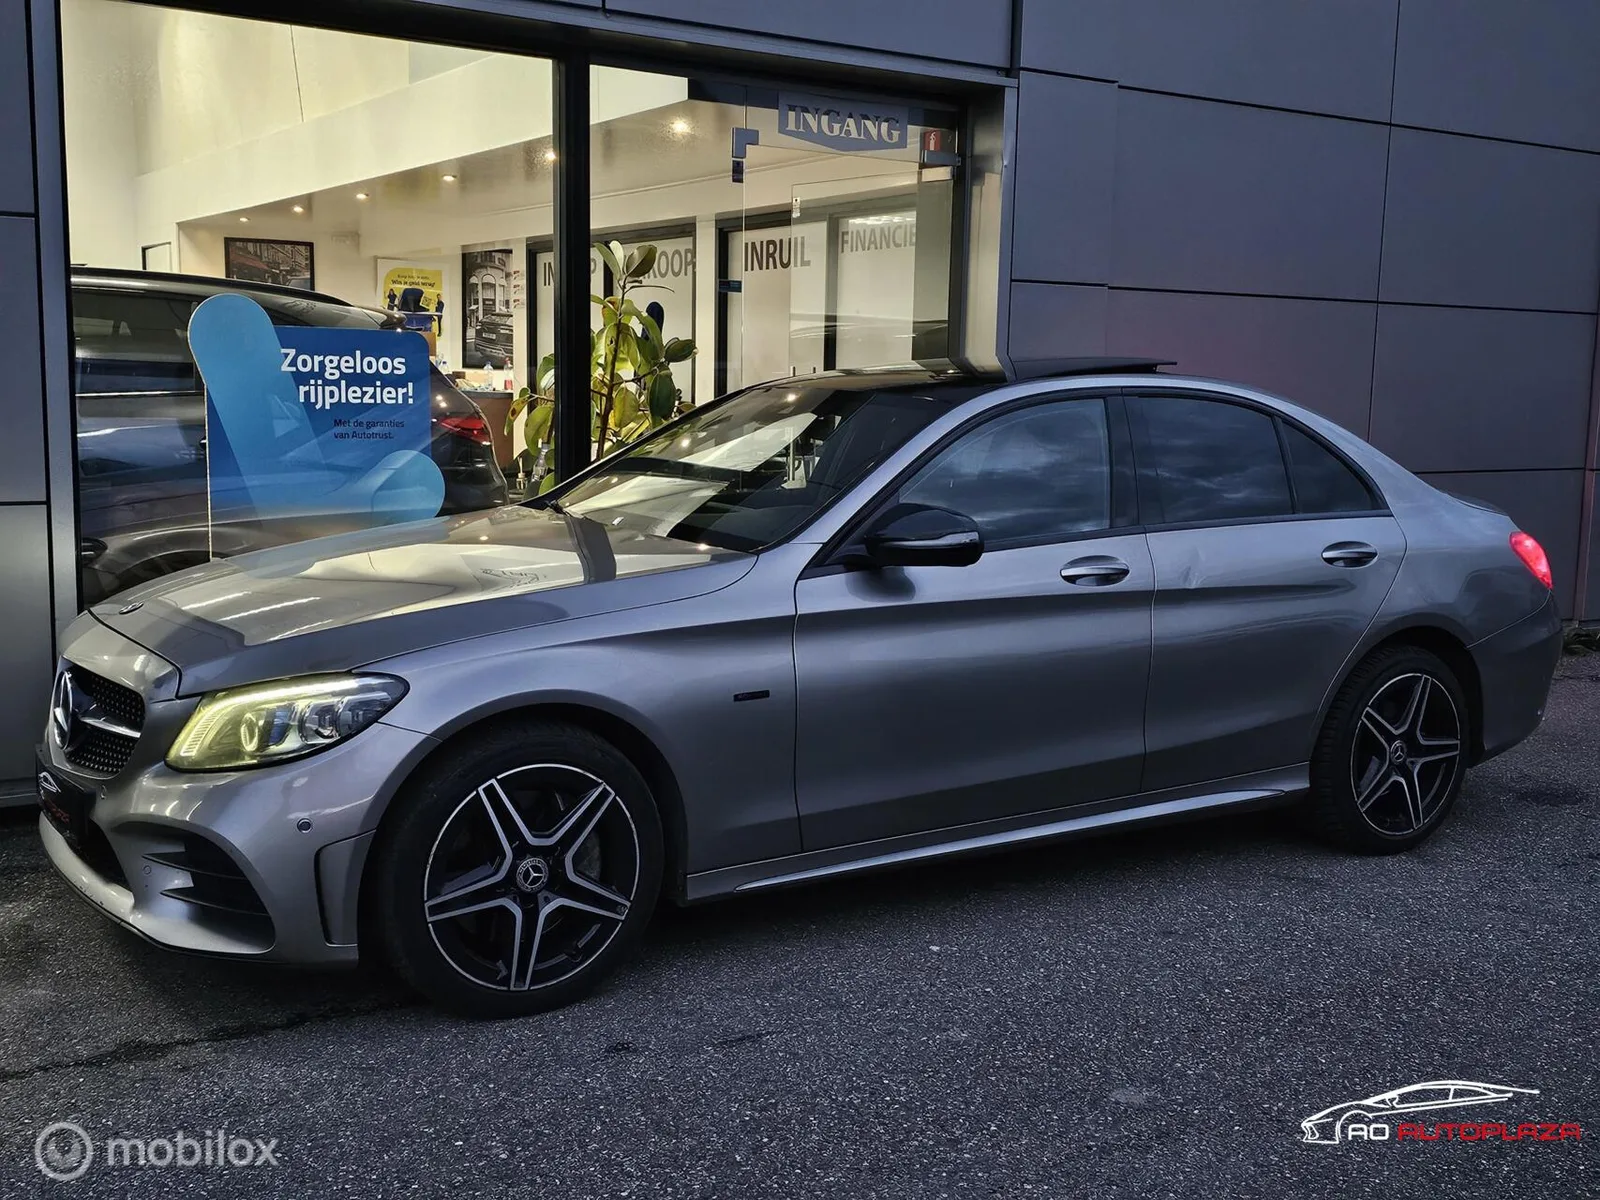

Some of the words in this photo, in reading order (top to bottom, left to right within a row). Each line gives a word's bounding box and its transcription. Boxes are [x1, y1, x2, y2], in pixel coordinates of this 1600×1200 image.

[786, 104, 901, 144] INGANG
[744, 235, 811, 271] INRUIL
[280, 348, 407, 380] Zorgeloos
[299, 379, 414, 410] rijplezier!
[334, 419, 351, 428] Met
[353, 419, 364, 428] de
[365, 420, 405, 430] garanties
[351, 431, 394, 440] Autotrust.
